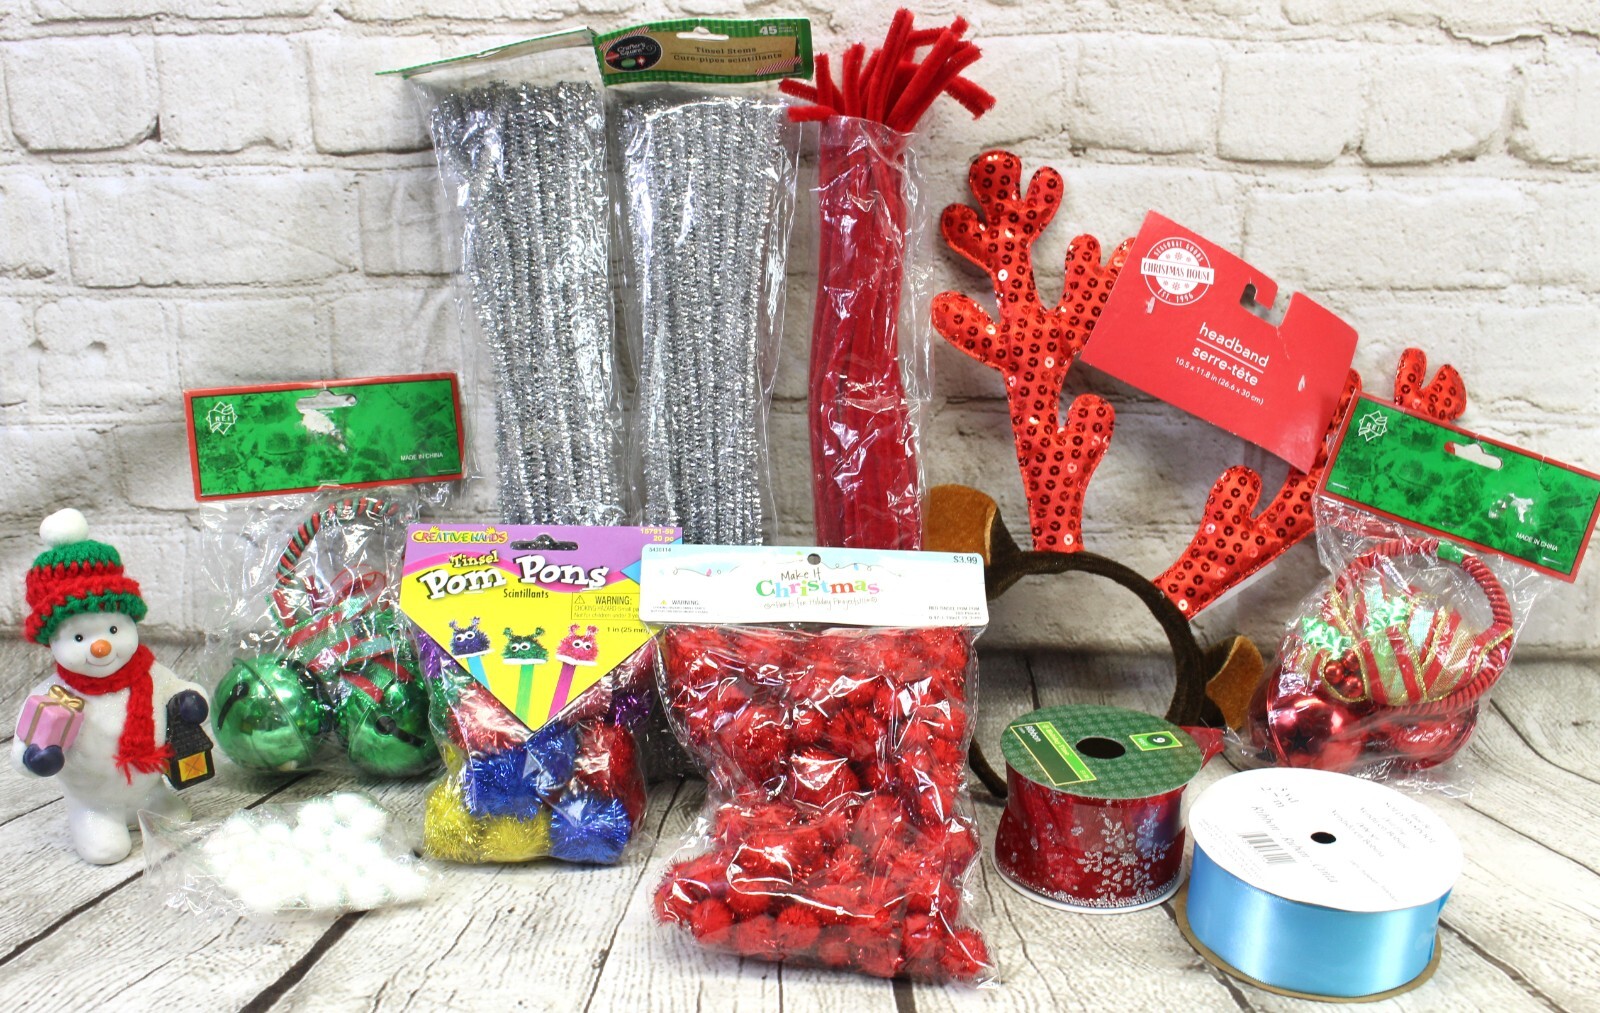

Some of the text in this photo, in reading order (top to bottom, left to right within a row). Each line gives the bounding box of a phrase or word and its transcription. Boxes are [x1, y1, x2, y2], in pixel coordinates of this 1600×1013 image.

[759, 25, 778, 36] 45
[694, 46, 757, 55] Tinsel Stems
[727, 52, 782, 63] scintillants
[1143, 261, 1210, 281] CHRISTMAS HOUSE
[1199, 321, 1270, 367] headband
[1191, 346, 1259, 386] serre-tête
[1175, 356, 1190, 369] 10.5
[1196, 366, 1211, 379] 11.8
[1218, 376, 1235, 391] (26.6
[1241, 388, 1251, 398] 30
[1250, 395, 1264, 406] cm)
[425, 451, 444, 459] CHINA
[411, 530, 469, 543] CREATIVE
[1516, 532, 1533, 543] MADE
[1540, 540, 1558, 552] CHINA
[450, 549, 499, 568] Tinsel
[953, 555, 978, 565] $3.99
[416, 554, 610, 600] Pom Pons
[781, 567, 821, 581] Make It
[503, 588, 549, 599] Scintillants
[756, 579, 880, 598] Christmas
[595, 595, 633, 605] WARNING:
